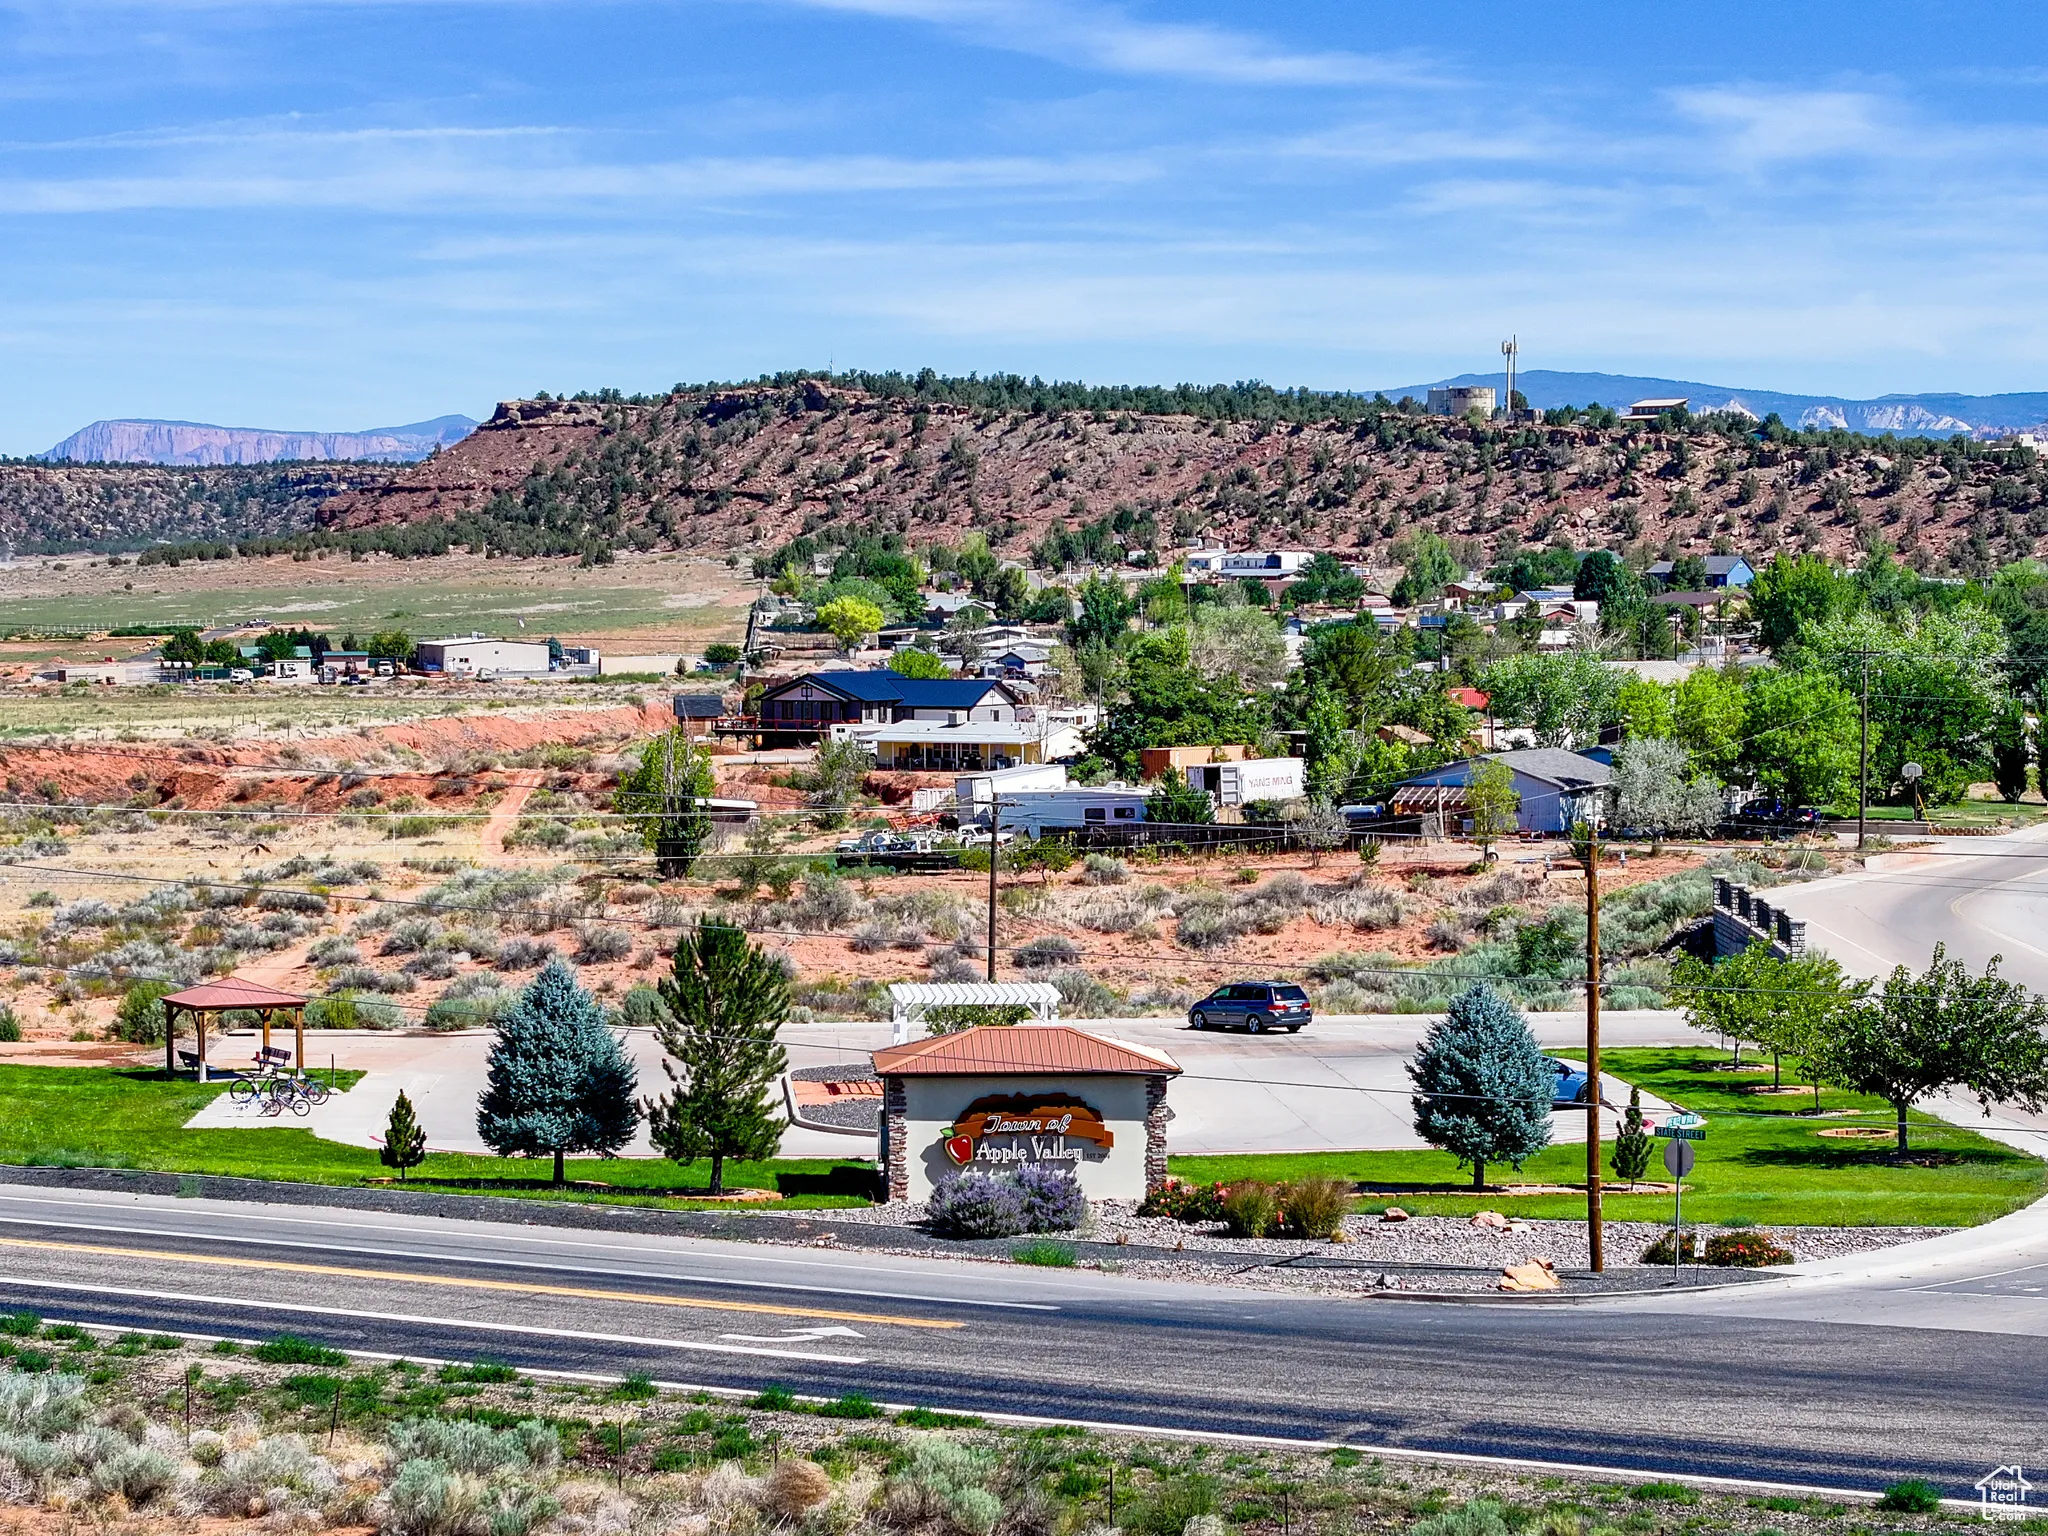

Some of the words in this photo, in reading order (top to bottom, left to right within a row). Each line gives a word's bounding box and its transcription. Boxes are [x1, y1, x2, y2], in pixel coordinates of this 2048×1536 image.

[984, 1115, 1041, 1133] Town
[1045, 1113, 1072, 1133] of
[1656, 1127, 1676, 1137] STATE
[1677, 1129, 1704, 1139] STREET
[975, 1136, 1028, 1164] Apple
[1031, 1135, 1083, 1162] Valley
